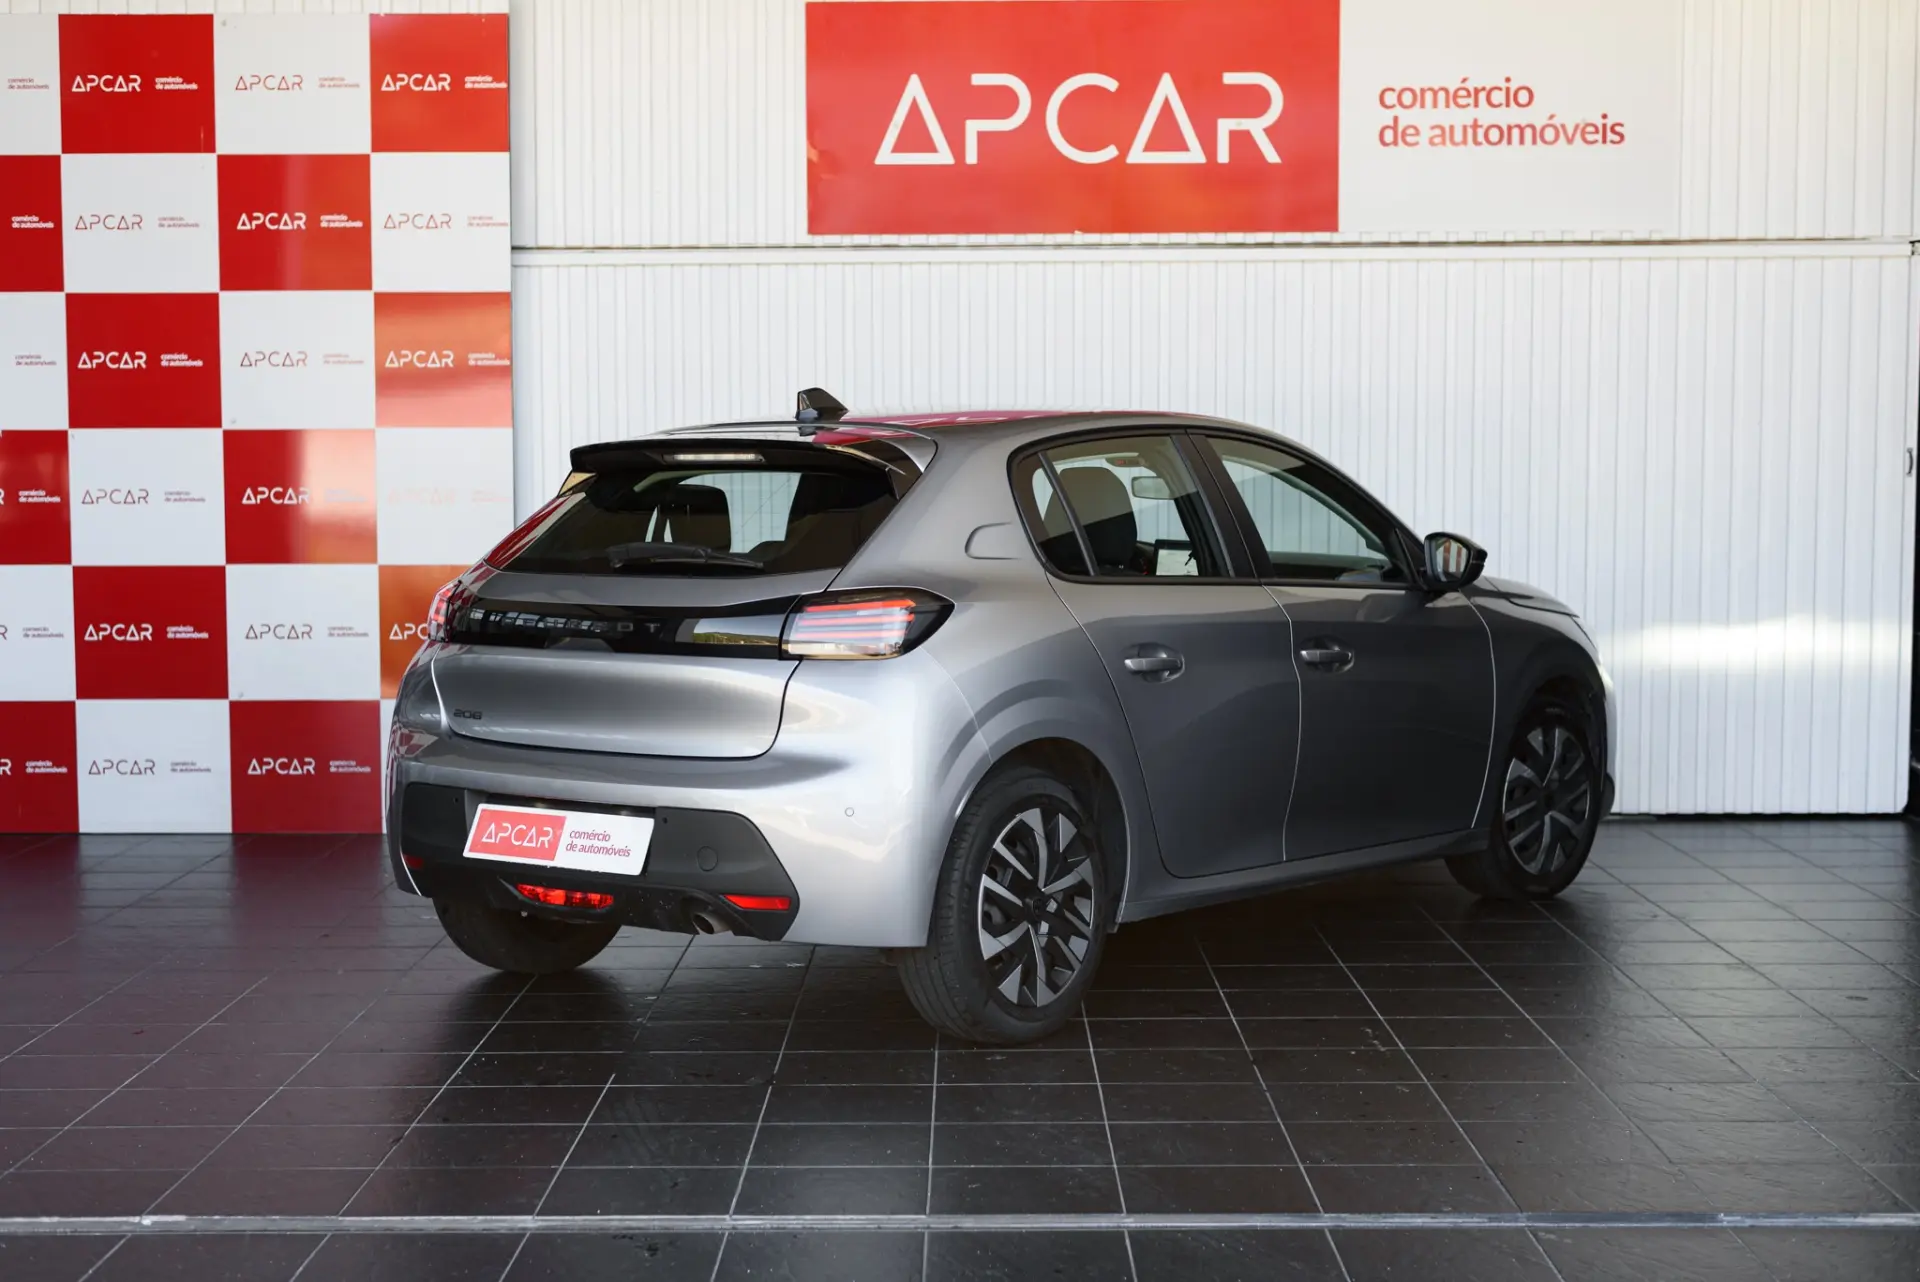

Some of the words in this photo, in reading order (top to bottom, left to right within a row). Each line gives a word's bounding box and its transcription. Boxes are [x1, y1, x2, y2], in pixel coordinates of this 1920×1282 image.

[72, 75, 141, 92] APCAR
[236, 75, 303, 90] APCAR
[381, 74, 450, 91] APCAR
[1378, 77, 1535, 109] comércio
[874, 72, 1284, 164] APCAR
[1378, 115, 1420, 147] de
[1428, 113, 1625, 147] automóveis
[75, 215, 142, 230] APCAR
[237, 212, 306, 230] APCAR
[384, 214, 451, 229] APCAR
[78, 351, 146, 368] APCAR
[240, 352, 307, 367] APCAR
[385, 350, 454, 367] APCAR
[82, 489, 148, 504] APCAR
[242, 487, 310, 504] APCAR
[84, 624, 152, 641] APCAR
[246, 624, 312, 639] APCAR
[388, 623, 429, 640] APC
[89, 760, 155, 775] APCAR
[248, 758, 315, 774] APCAR
[482, 822, 554, 849] APCAR
[569, 828, 611, 842] comércio
[566, 841, 578, 852] de
[578, 843, 632, 857] automóveis
